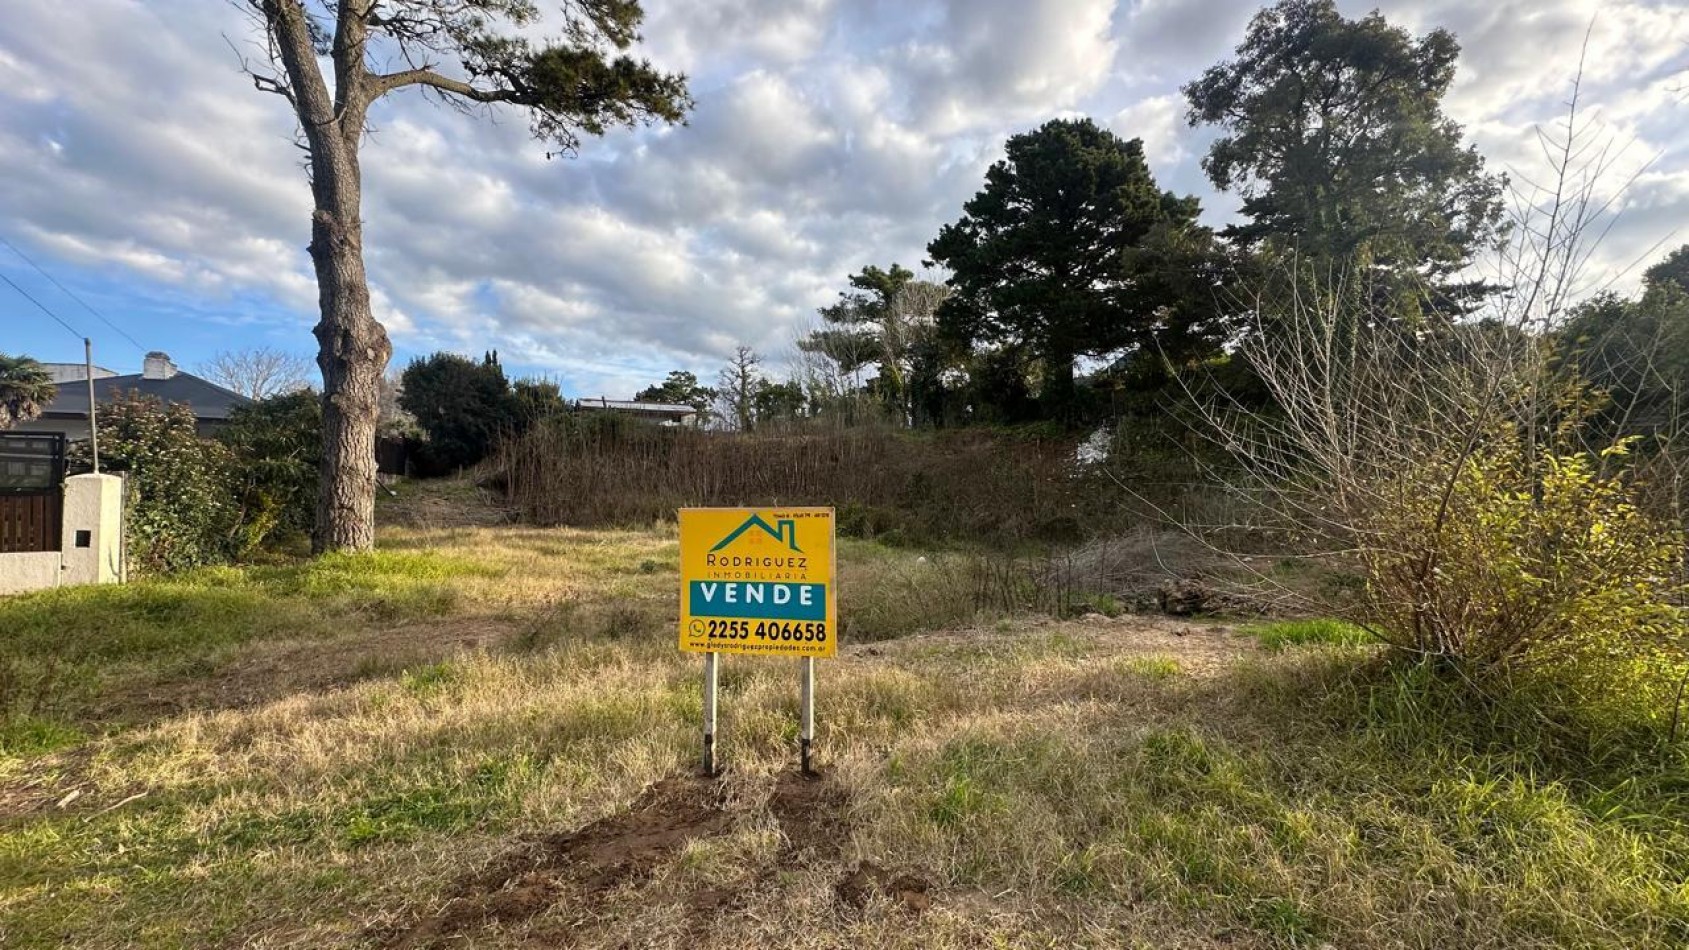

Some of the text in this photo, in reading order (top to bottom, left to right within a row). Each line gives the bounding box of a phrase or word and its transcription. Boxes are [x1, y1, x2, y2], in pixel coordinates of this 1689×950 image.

[707, 554, 807, 568] RODRIGUEZ
[707, 571, 807, 580] INMOBILIARIA
[701, 582, 813, 606] VENDE
[708, 620, 827, 642] 2255 406658
